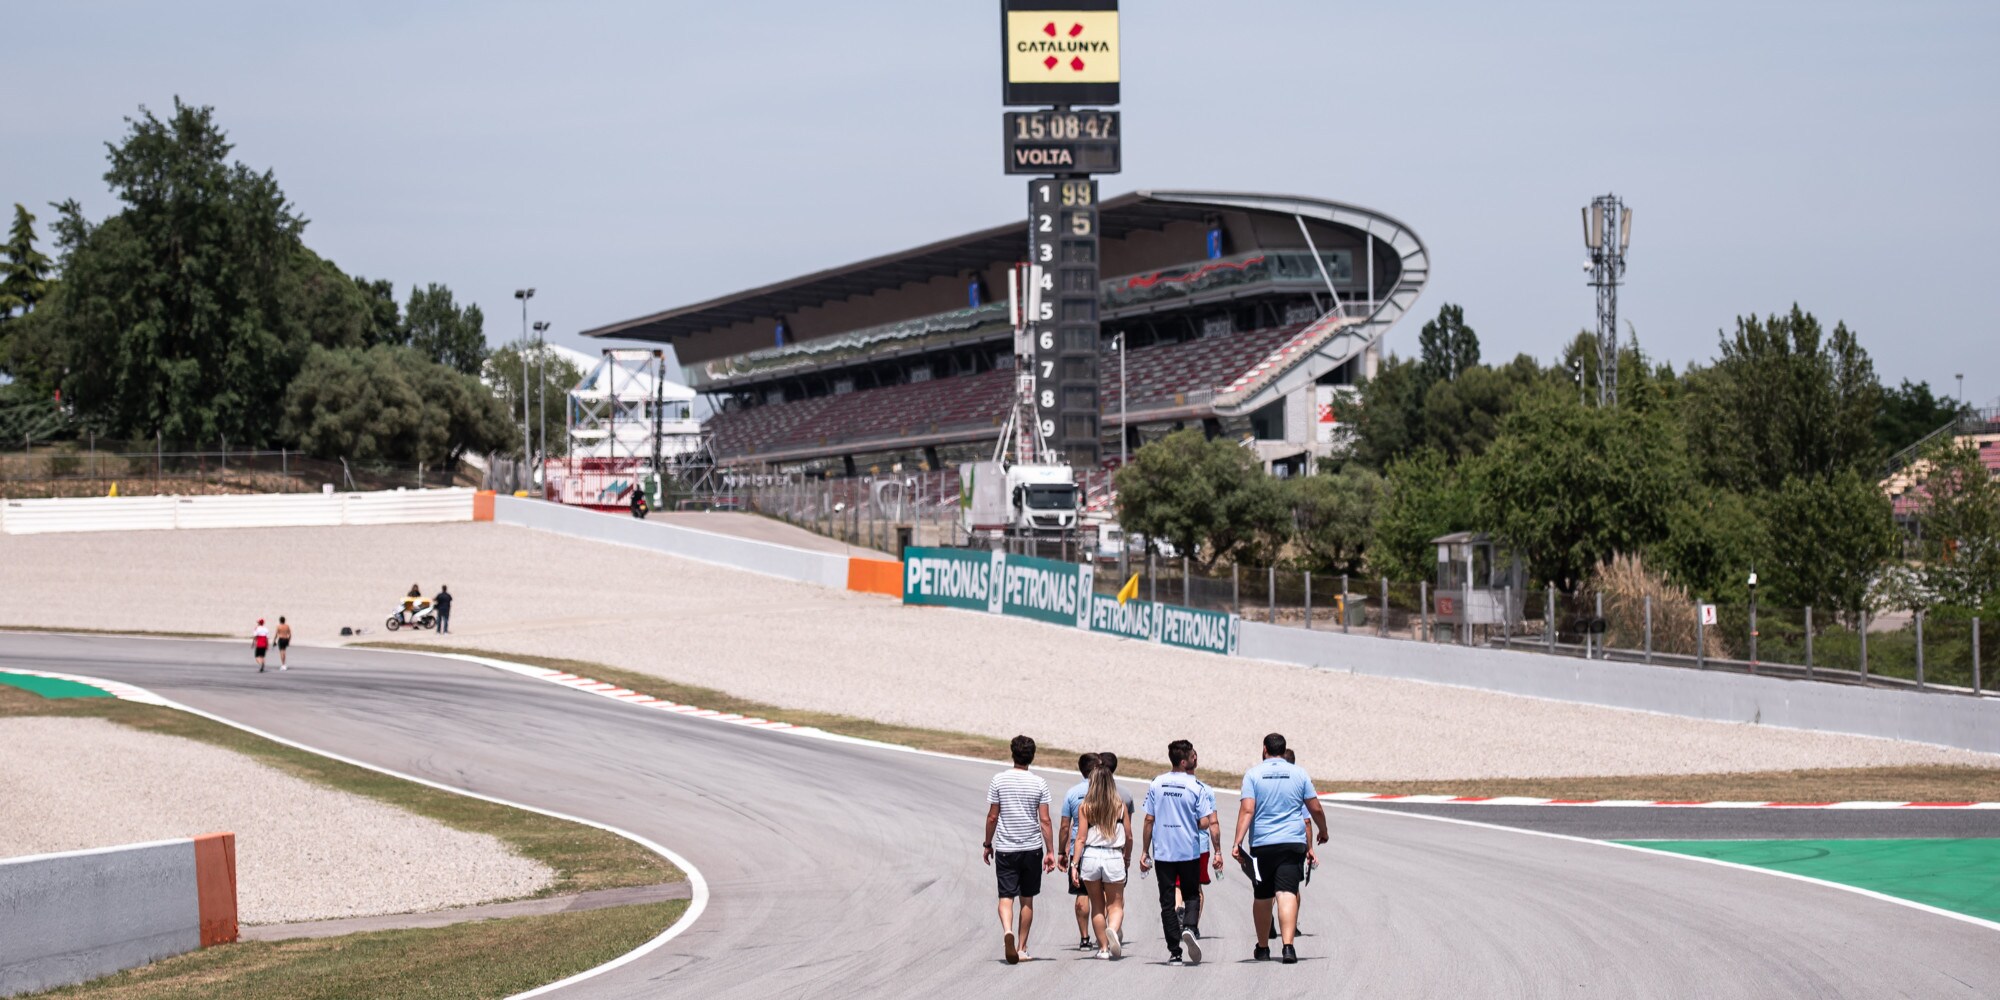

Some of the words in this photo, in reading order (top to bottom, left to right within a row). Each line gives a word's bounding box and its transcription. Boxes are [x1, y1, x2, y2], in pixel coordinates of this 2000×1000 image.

[1016, 41, 1110, 53] CATALUNYA
[1016, 149, 1072, 165] VOLTA
[1039, 185, 1050, 203] 1
[1062, 182, 1092, 207] 99
[1039, 214, 1053, 232] 2
[1071, 211, 1091, 236] 5
[1039, 243, 1053, 262] 3
[1040, 273, 1053, 291] 4
[1040, 302, 1053, 320] 5
[1039, 331, 1054, 350] 6
[1040, 360, 1055, 379] 7
[1040, 389, 1055, 408] 8
[1041, 419, 1056, 438] 9
[907, 557, 990, 601] PETRONAS
[1005, 565, 1077, 616] PETRONAS
[1092, 597, 1152, 638] PETRONAS
[1164, 608, 1227, 651] PETRONAS
